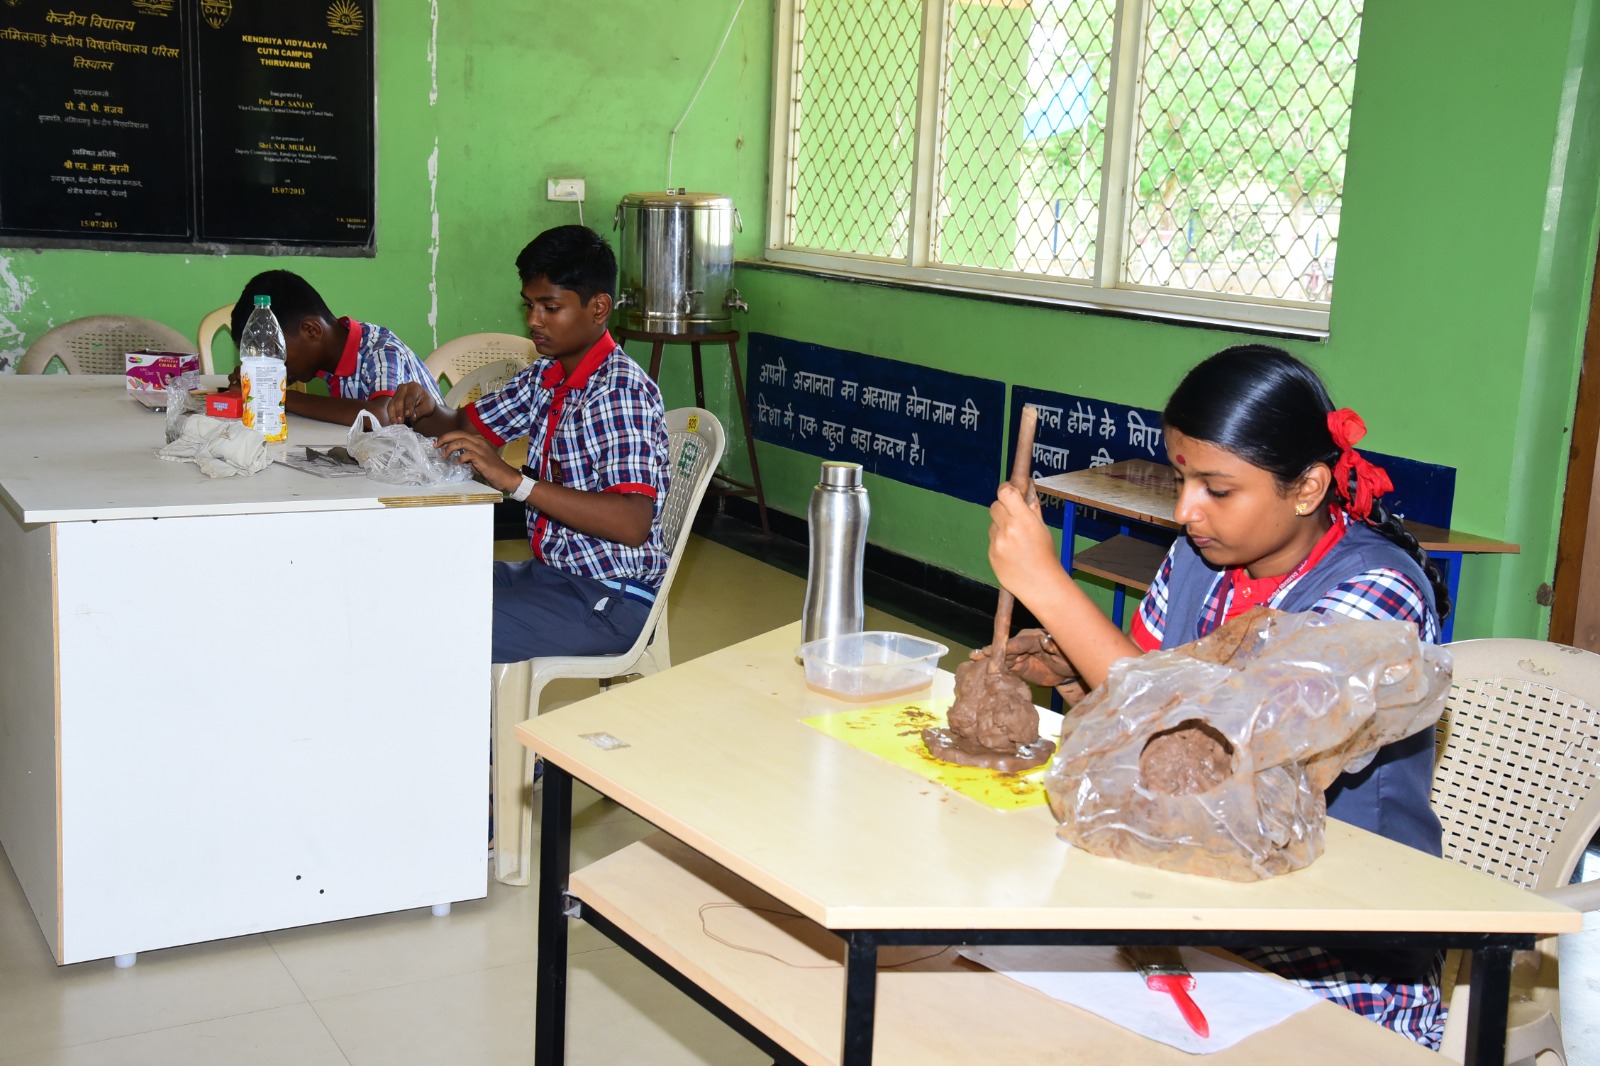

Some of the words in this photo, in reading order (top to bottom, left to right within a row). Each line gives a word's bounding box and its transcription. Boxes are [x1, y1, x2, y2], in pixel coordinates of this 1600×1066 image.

[45, 9, 87, 26] केन्द्रीय
[89, 14, 136, 31] विद्यालय
[0, 28, 47, 47] तमिलनाडु
[50, 33, 83, 48] केन्द्रीय
[151, 45, 180, 58] परिसर
[242, 35, 283, 46] KENDRIYA
[284, 39, 327, 50] VIDYALAYA
[257, 47, 280, 56] CUTN
[281, 49, 313, 59] CAMPUS
[260, 58, 311, 69] THIRUVARUR
[103, 104, 124, 114] संजय
[258, 98, 273, 106] Prof.
[288, 101, 314, 109] SANJAY
[288, 144, 316, 152] MURALI
[109, 163, 130, 175] मुरली
[271, 186, 305, 195] 15/07/2013
[80, 220, 118, 228] 15/07/2013
[759, 356, 787, 387] अपनी
[792, 371, 835, 398] अज्ञानता
[840, 380, 858, 402] का
[861, 386, 901, 413] अहसास
[905, 385, 931, 421] होना
[932, 400, 956, 425] ज्ञान
[960, 397, 980, 432] की
[757, 392, 781, 427] दिशा
[783, 402, 794, 430] में
[798, 413, 818, 439] एक
[822, 420, 846, 452] बहुत
[850, 427, 872, 454] बड़ा
[873, 433, 907, 462] कदम
[1025, 402, 1063, 430] फल
[1067, 401, 1096, 437] होने
[1099, 407, 1116, 440] के
[1127, 410, 1161, 457] लिए
[1032, 442, 1069, 470] फलता
